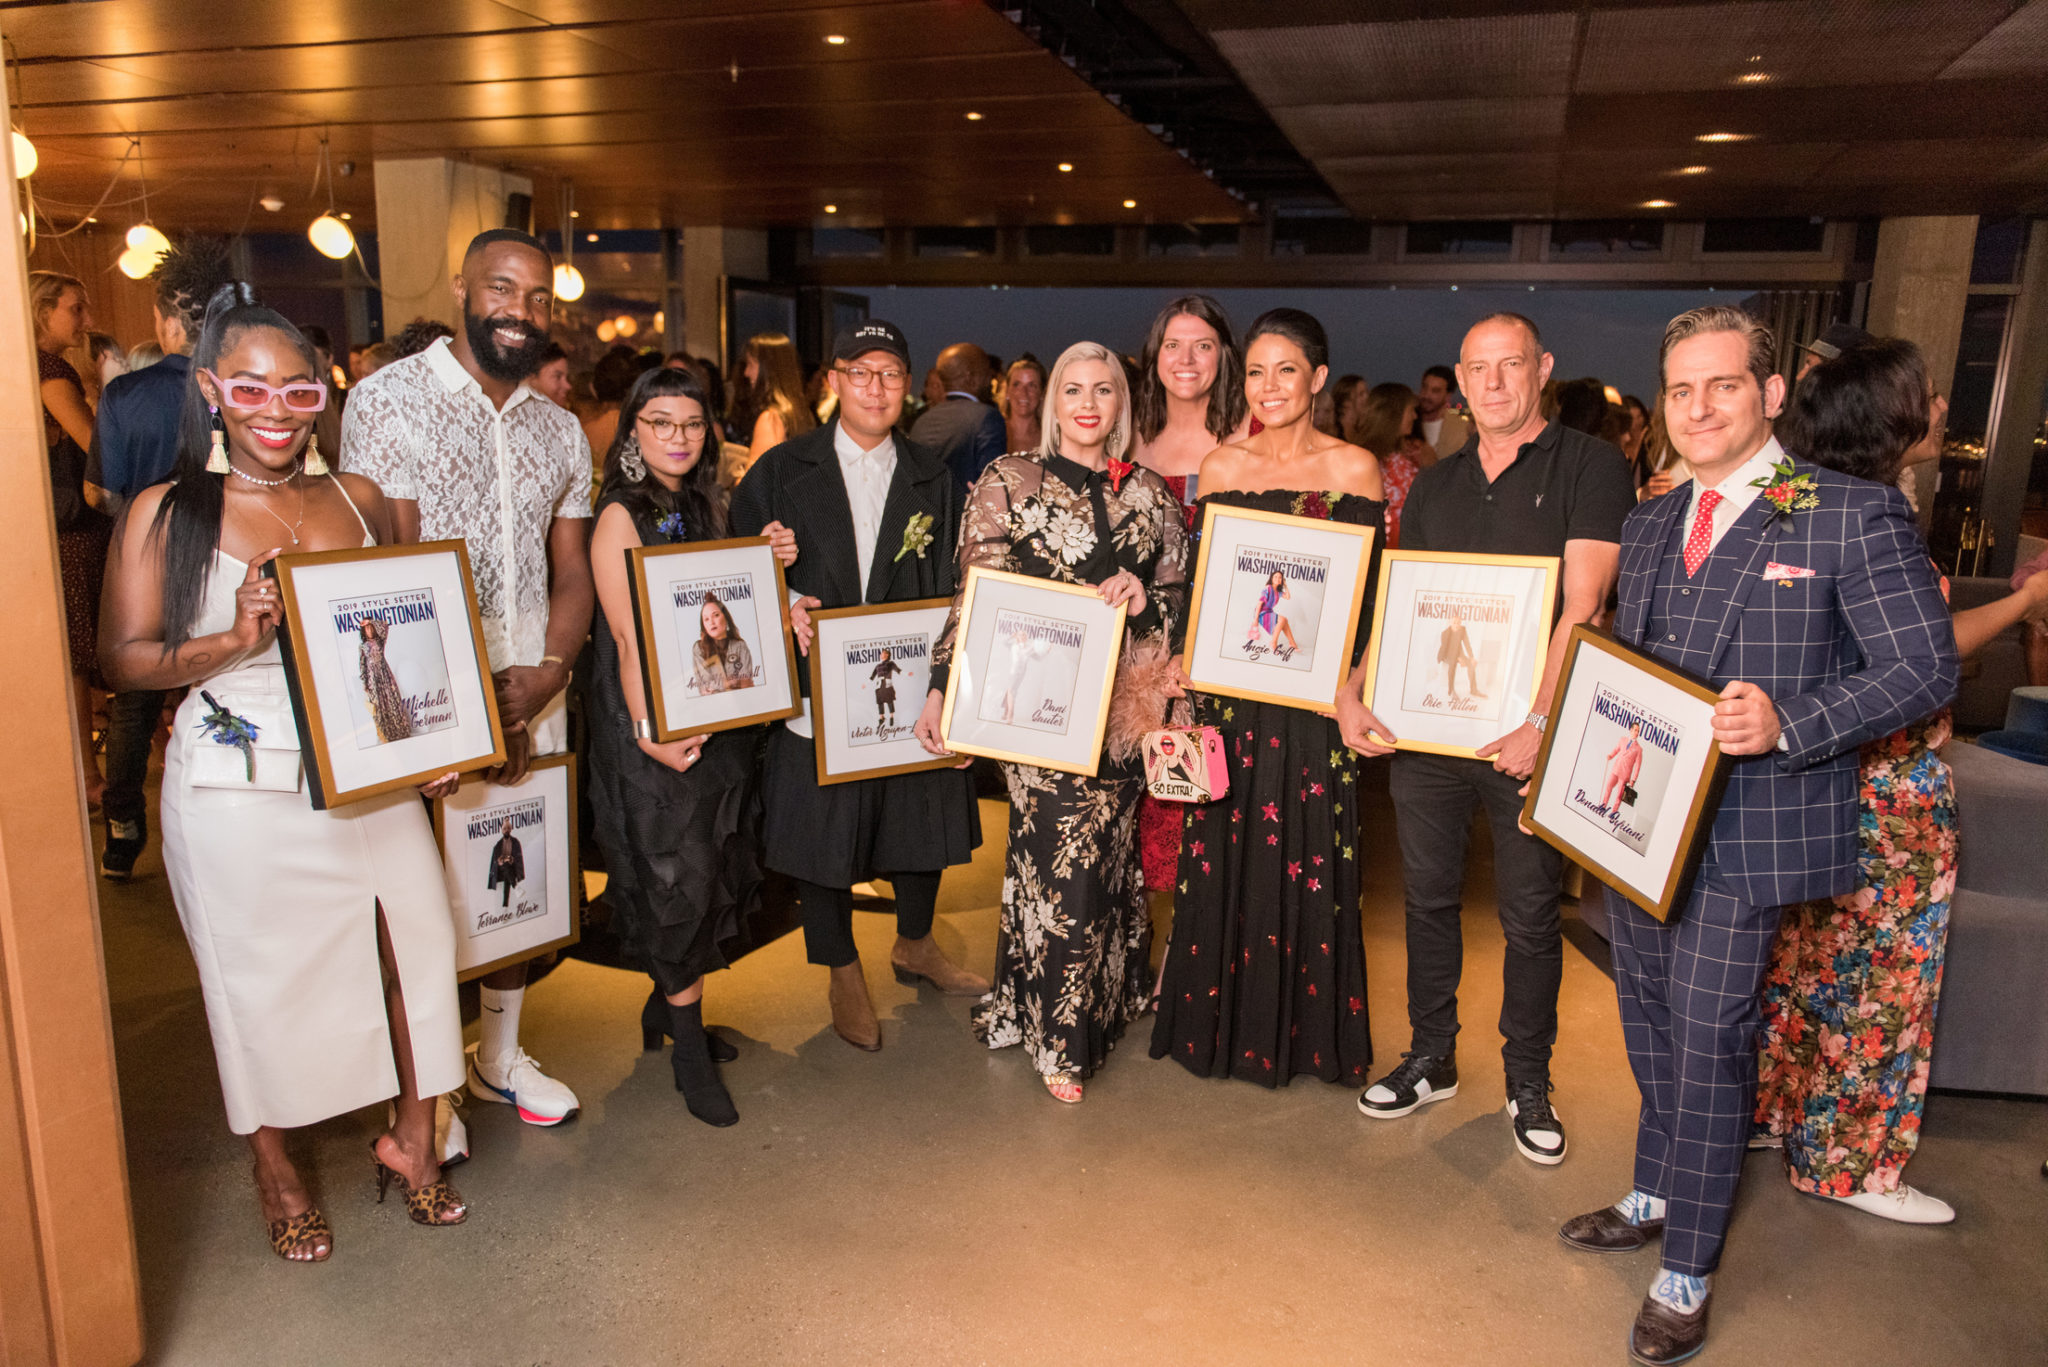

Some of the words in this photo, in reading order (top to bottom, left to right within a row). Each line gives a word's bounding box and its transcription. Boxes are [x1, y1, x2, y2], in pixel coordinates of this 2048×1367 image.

[1264, 552, 1288, 561] STYLE
[1292, 557, 1323, 566] SETTER
[1238, 556, 1326, 583] WASHINGTONIAN
[337, 603, 358, 611] 2019
[362, 598, 390, 608] STYLE
[394, 593, 426, 604] SETTER
[1418, 601, 1510, 624] WASHINGTONIAN
[401, 688, 448, 715] Michelle
[411, 711, 452, 728] German
[1602, 689, 1619, 701] 2019
[1622, 700, 1645, 716] STYLE
[1649, 714, 1678, 734] SETTER
[1154, 783, 1164, 794] SO
[1167, 784, 1194, 797] EXTRA!
[471, 813, 486, 821] 2019
[490, 808, 511, 817] STYLE
[514, 802, 539, 812] SETTER
